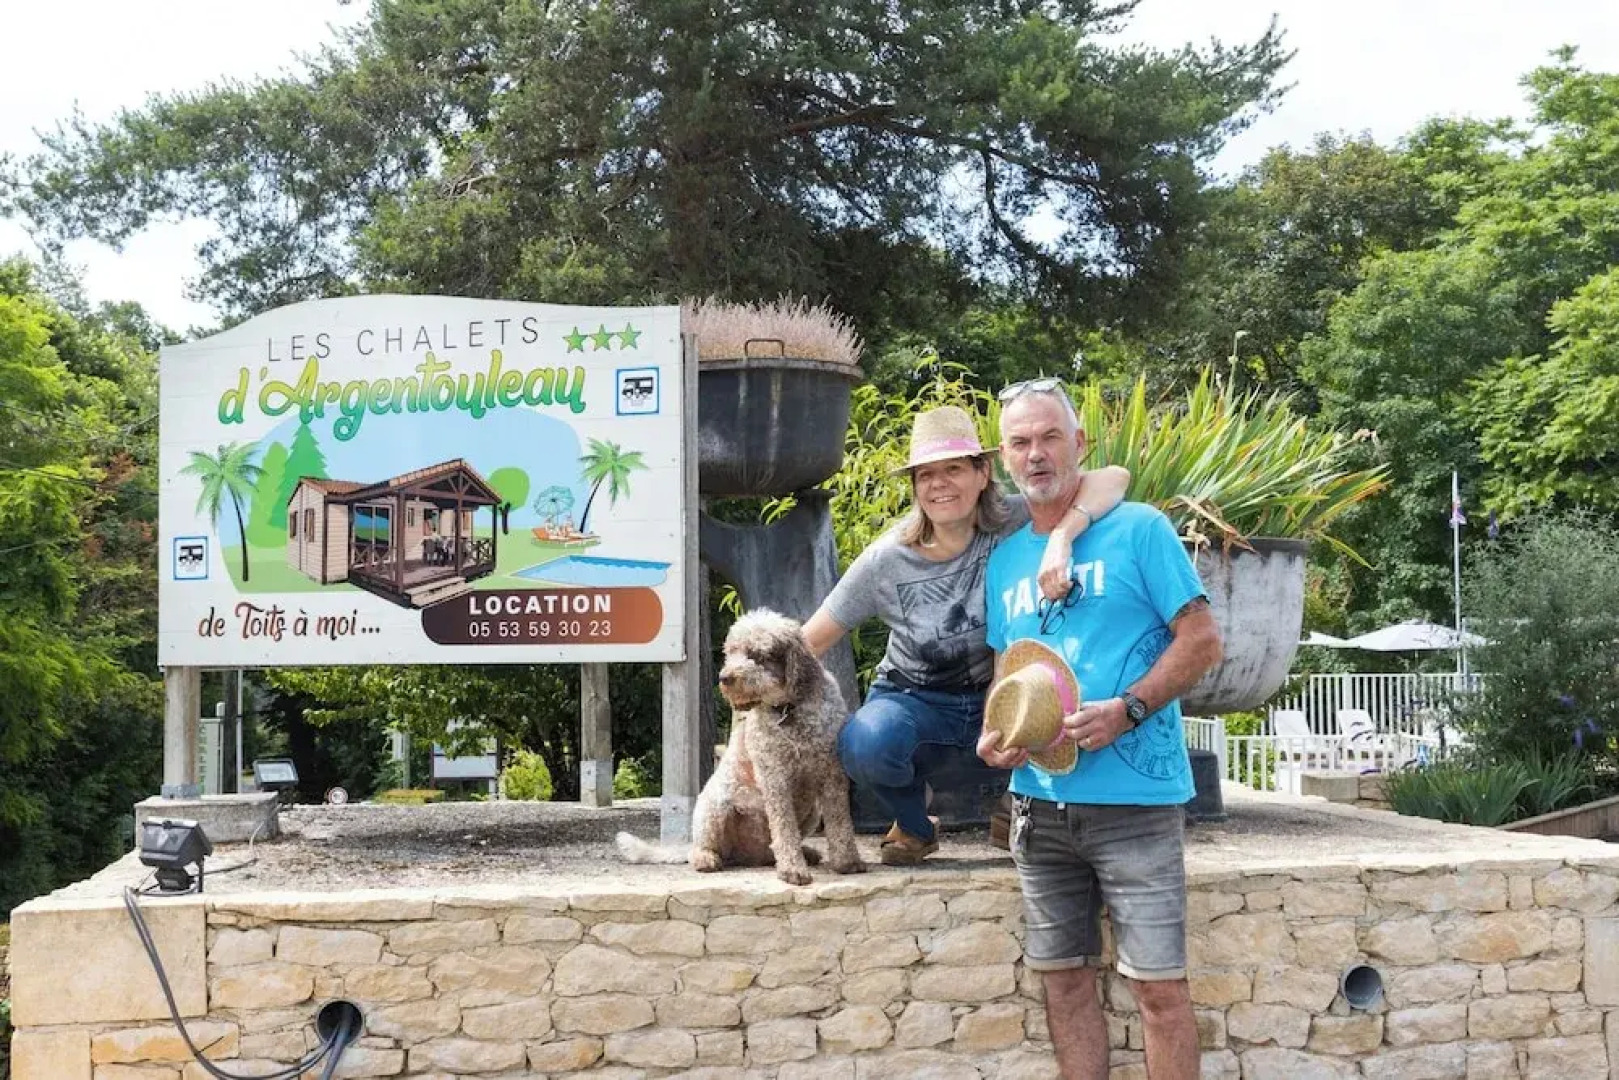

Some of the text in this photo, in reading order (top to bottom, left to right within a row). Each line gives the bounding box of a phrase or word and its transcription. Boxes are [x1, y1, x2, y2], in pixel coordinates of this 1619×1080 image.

[268, 316, 539, 362] LES CHALETS
[218, 349, 587, 441] d'Argentouleau
[469, 594, 612, 615] LOCATION
[1002, 559, 1105, 624] TATI
[199, 606, 226, 638] de
[235, 601, 287, 642] Toits
[293, 609, 308, 637] à
[469, 619, 612, 637] 05 53 59 30 23
